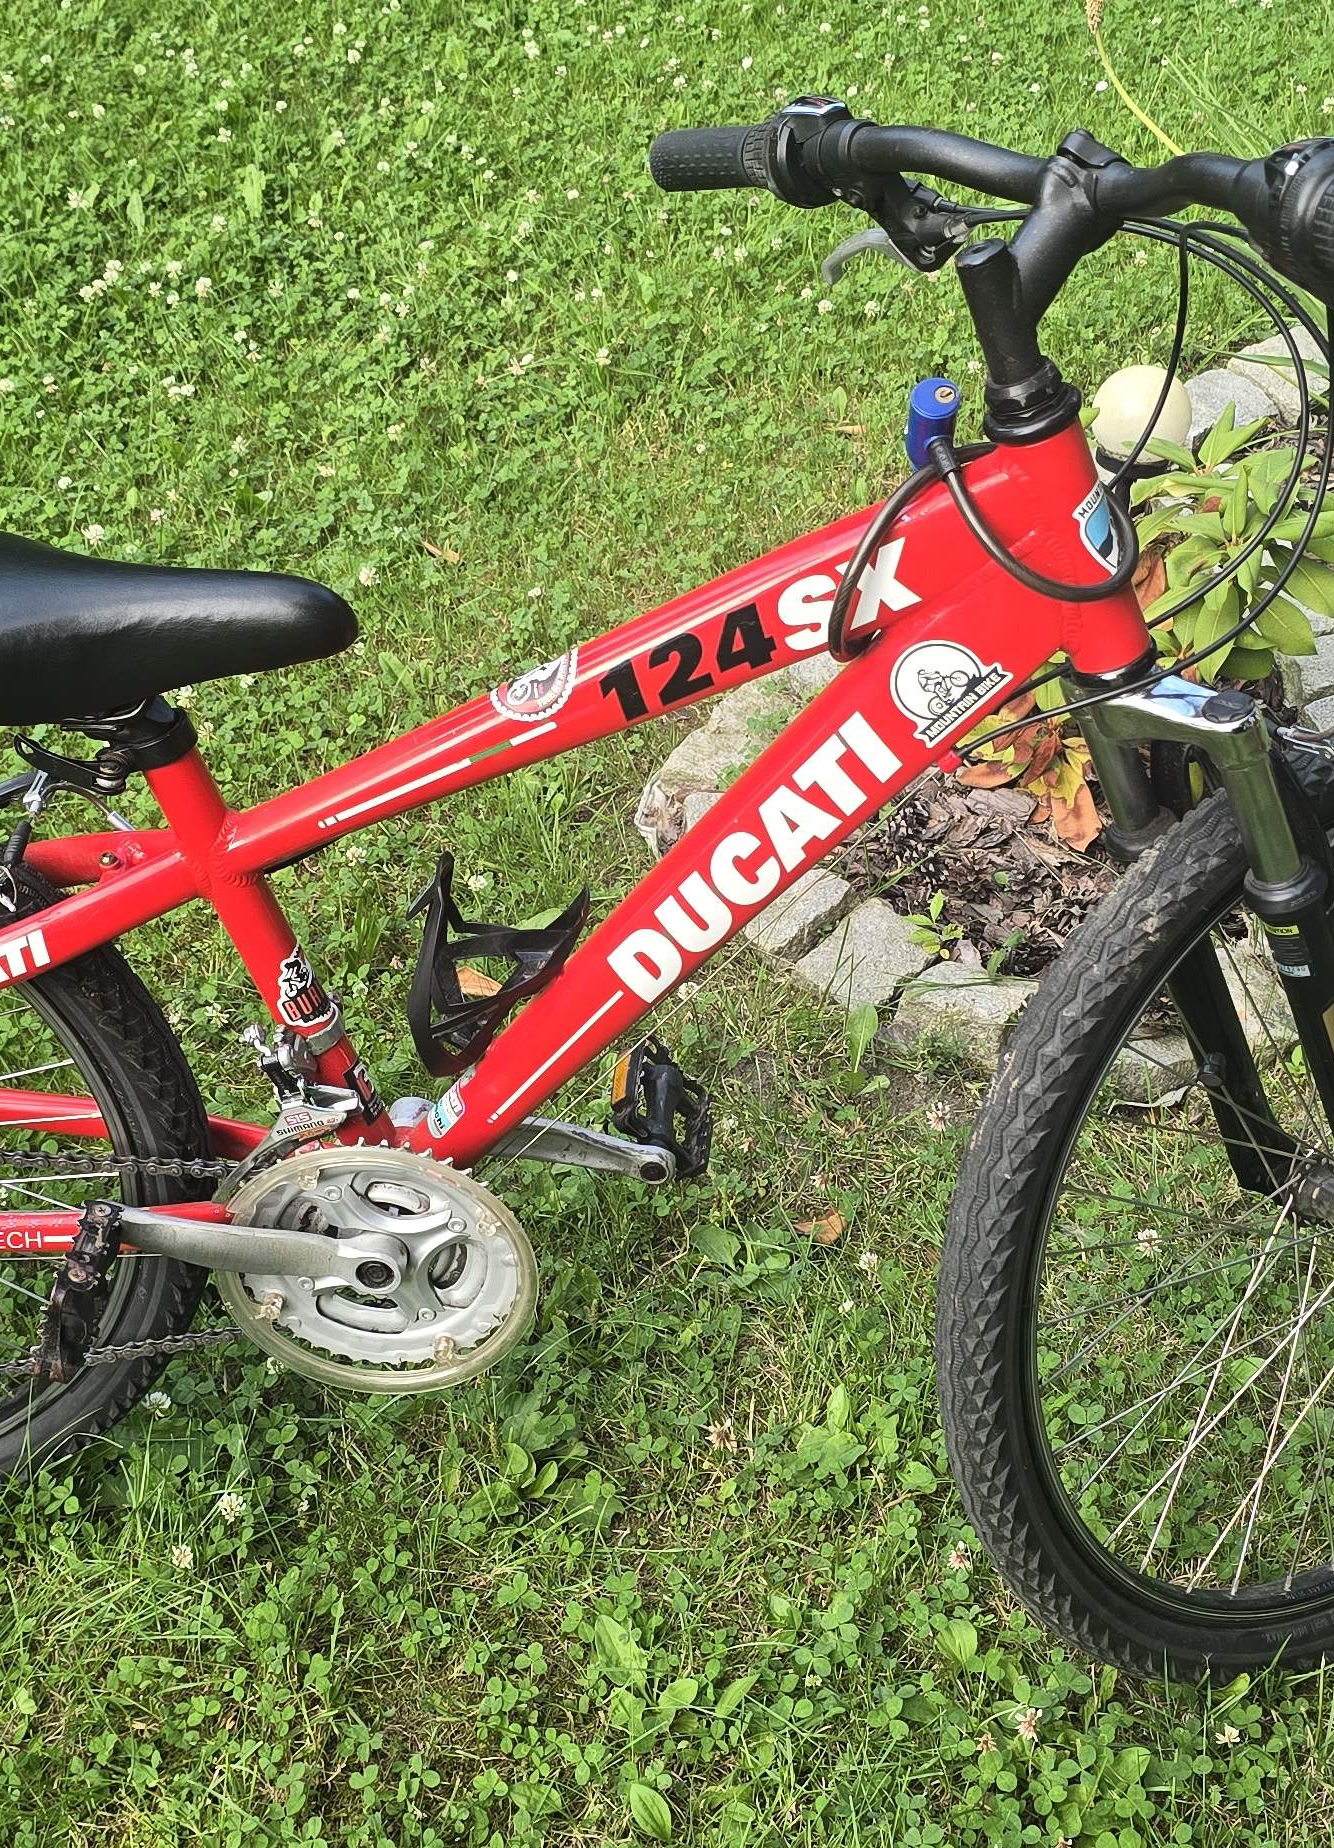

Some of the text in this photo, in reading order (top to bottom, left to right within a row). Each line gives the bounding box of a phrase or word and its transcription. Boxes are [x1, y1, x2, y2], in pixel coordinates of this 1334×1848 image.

[1078, 485, 1102, 519] MOUN
[926, 672, 1002, 738] MOUNTAIN BIKE
[607, 710, 903, 1004] DUCATI
[276, 1120, 325, 1136] SHIMANO
[286, 1113, 310, 1126] SIS
